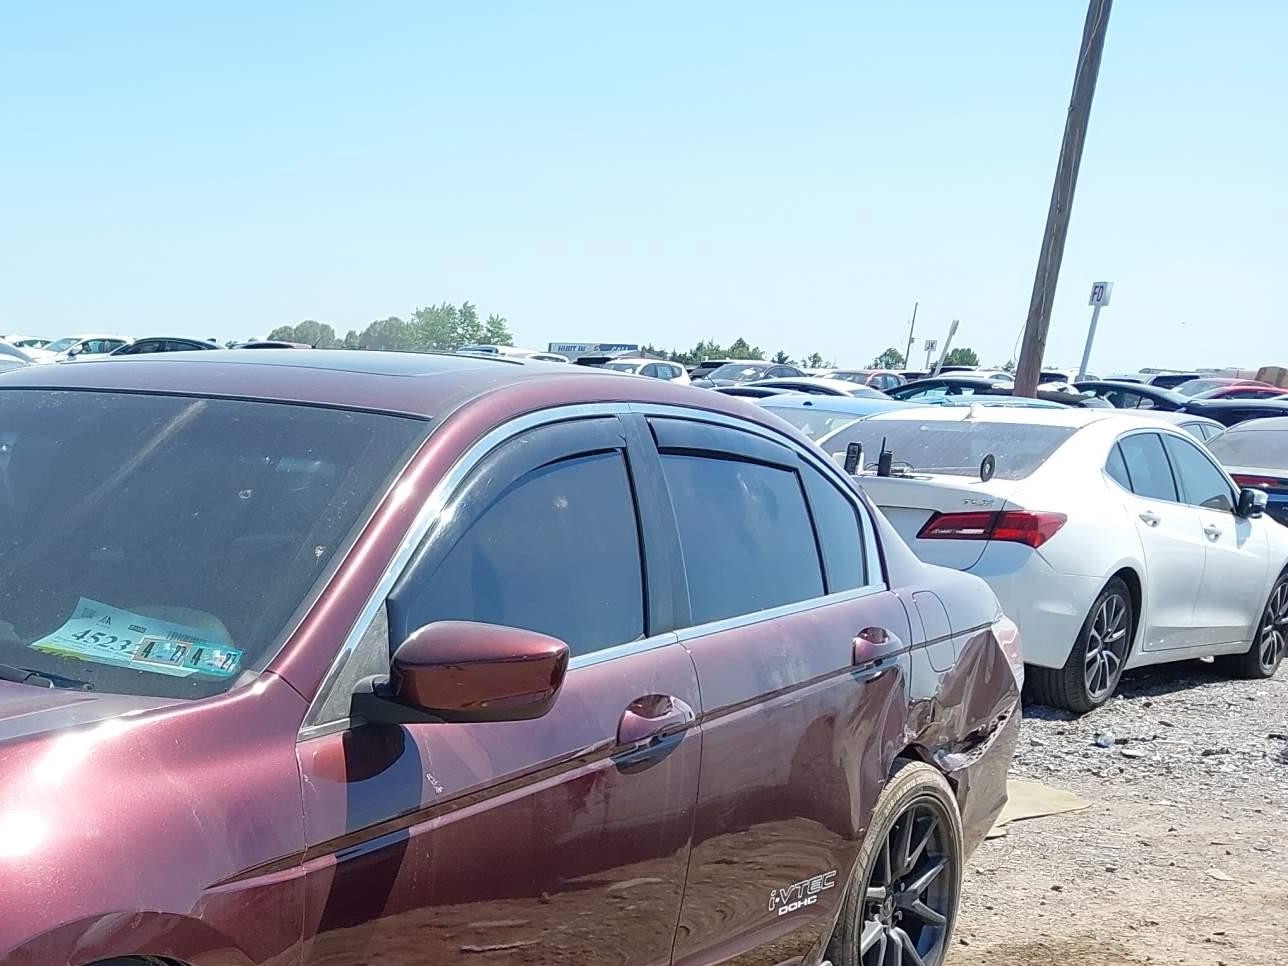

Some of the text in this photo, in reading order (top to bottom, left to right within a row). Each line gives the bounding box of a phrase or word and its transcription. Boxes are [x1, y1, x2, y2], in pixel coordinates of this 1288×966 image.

[141, 641, 156, 659] 4
[191, 647, 205, 666] 4
[778, 894, 818, 916] DOHC
